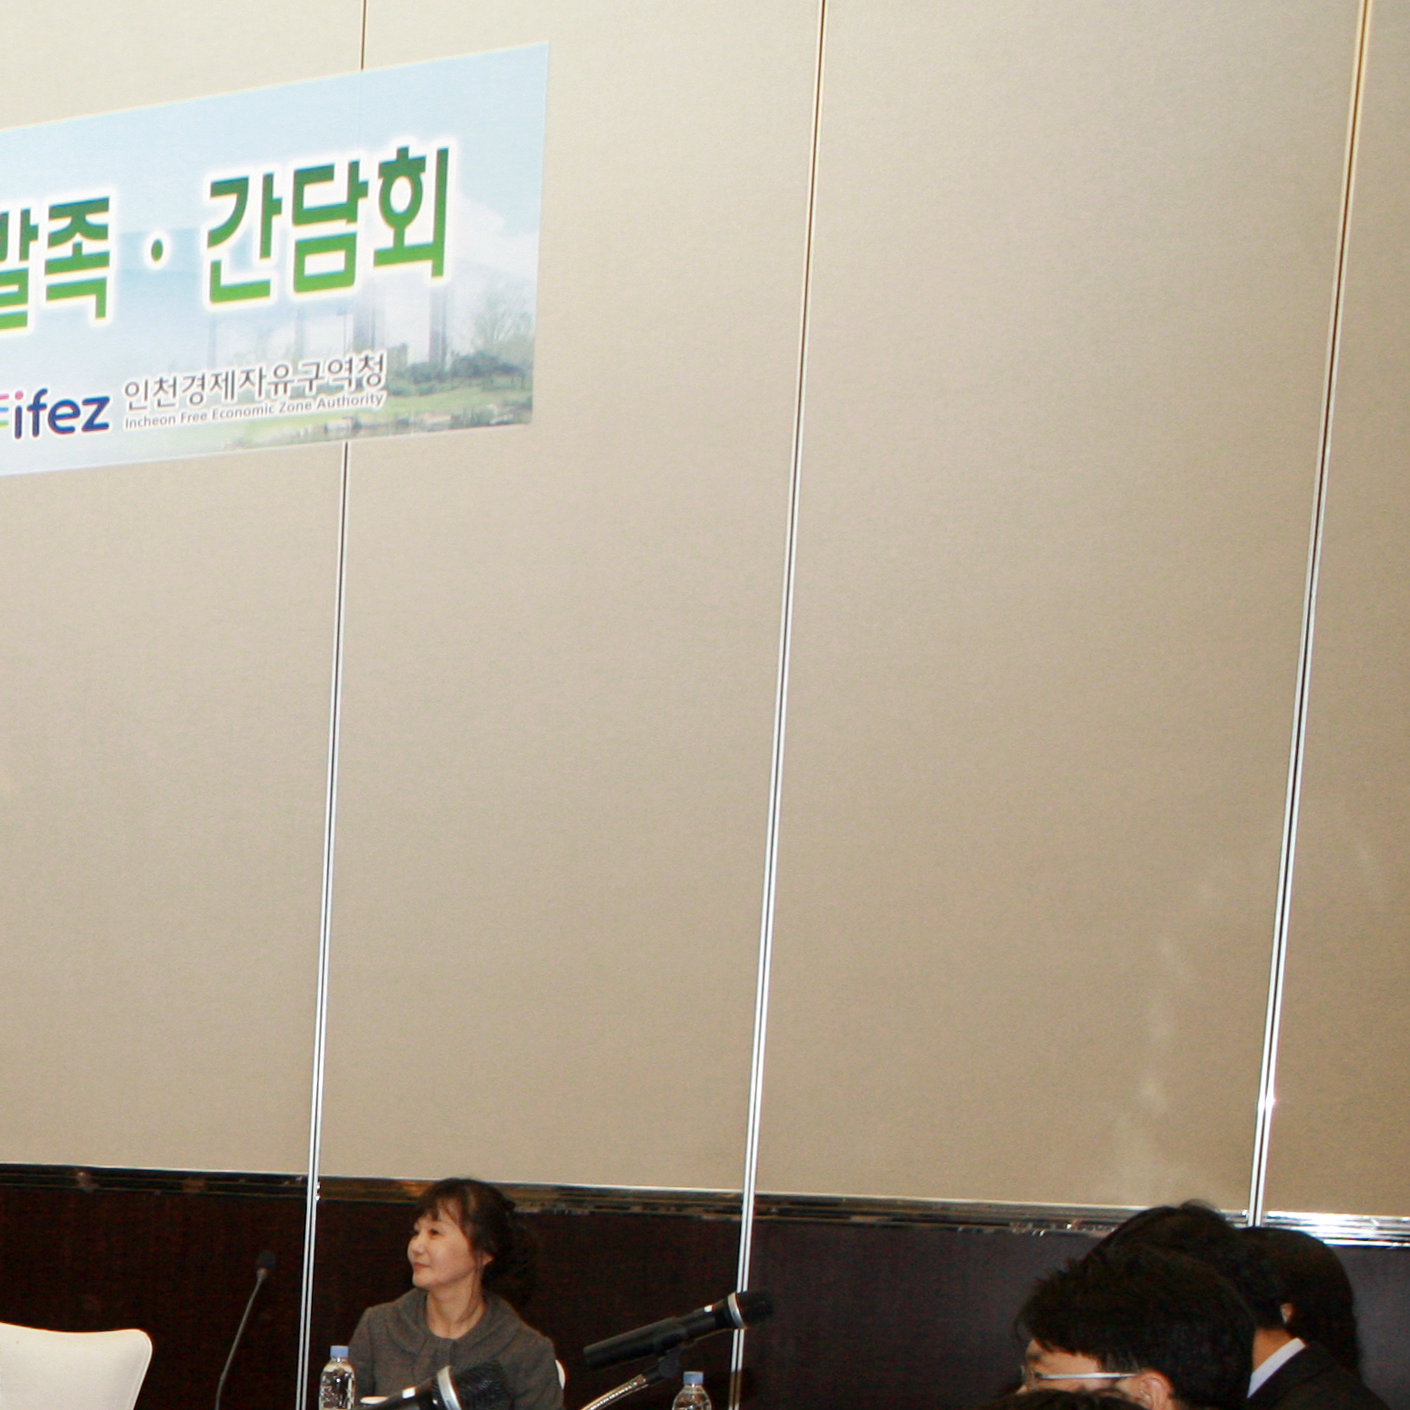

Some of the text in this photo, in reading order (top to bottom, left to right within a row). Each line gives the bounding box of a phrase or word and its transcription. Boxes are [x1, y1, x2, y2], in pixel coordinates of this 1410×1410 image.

[207, 145, 451, 305] 간담회
[124, 352, 386, 411] 인천경제자유구역청
[14, 388, 111, 440] ifez
[125, 391, 386, 429] Incheon Free Economic Zone Authority
